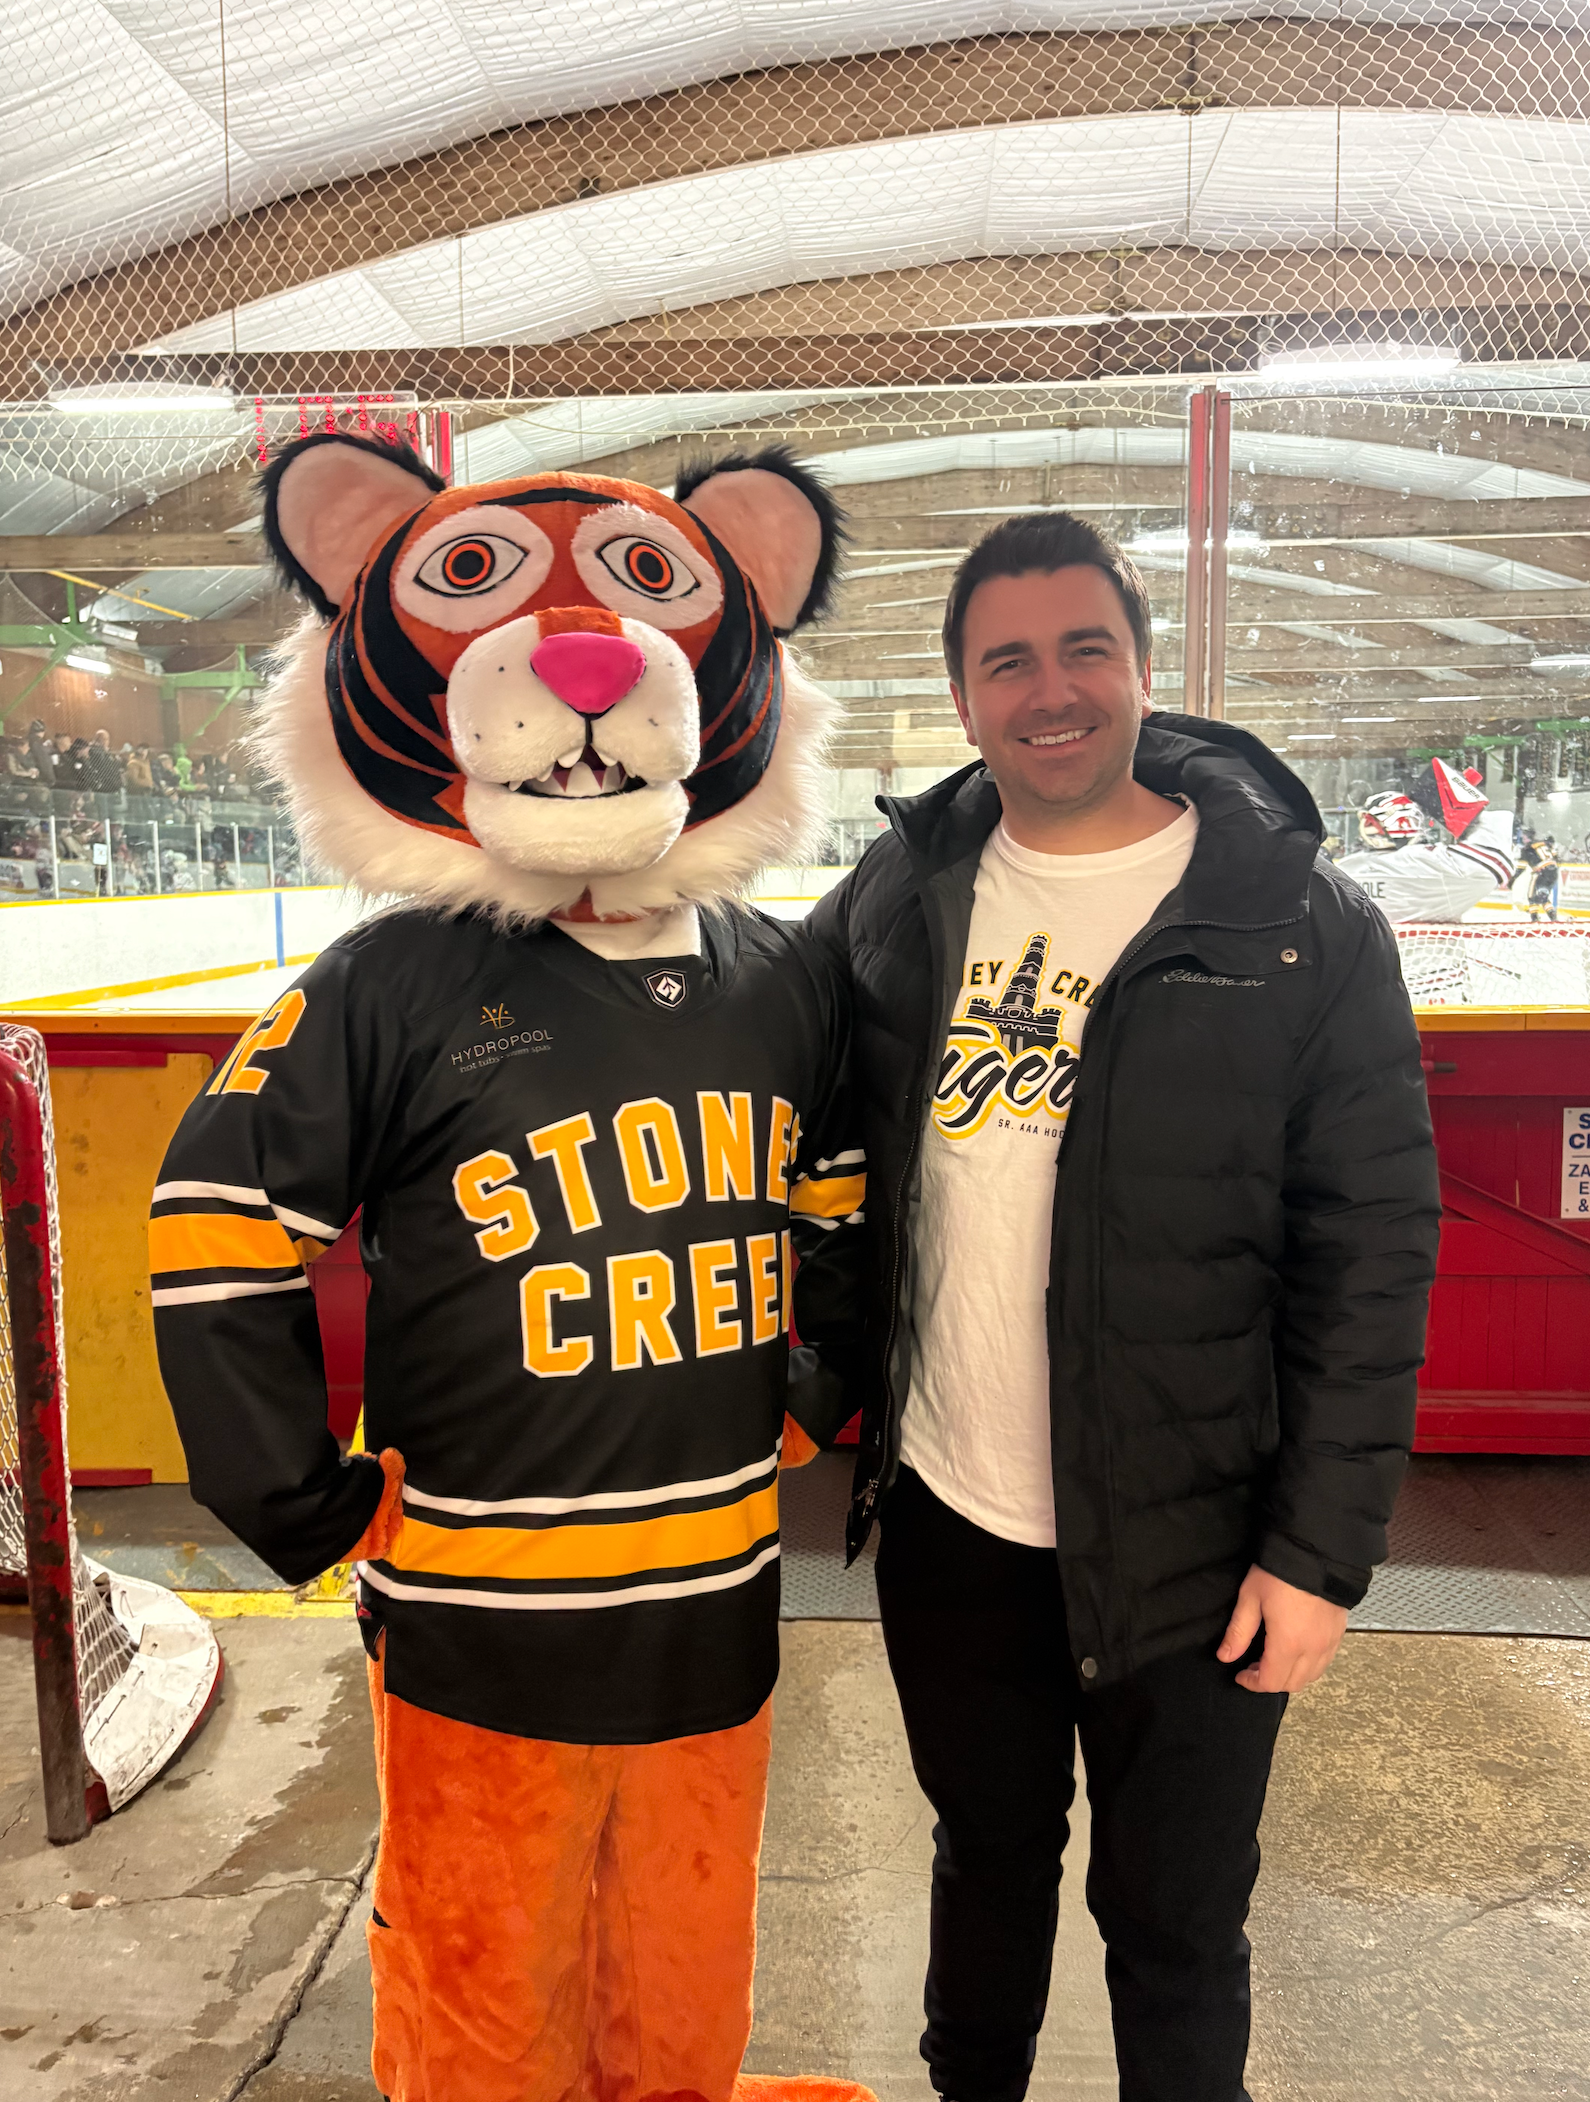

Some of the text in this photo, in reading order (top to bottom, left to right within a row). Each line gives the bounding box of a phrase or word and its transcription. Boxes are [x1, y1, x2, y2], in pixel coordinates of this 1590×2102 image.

[1451, 776, 1481, 800] BAUER
[1360, 881, 1386, 899] OLE
[961, 960, 1005, 988] EY
[450, 1028, 554, 1066] HYDROPOOL
[479, 1054, 501, 1068] tubs
[531, 1043, 552, 1055] spas
[997, 1118, 1015, 1131] SR.
[1019, 1122, 1039, 1136] AAA
[1569, 1133, 1590, 1150] C
[451, 1090, 794, 1263] STONE
